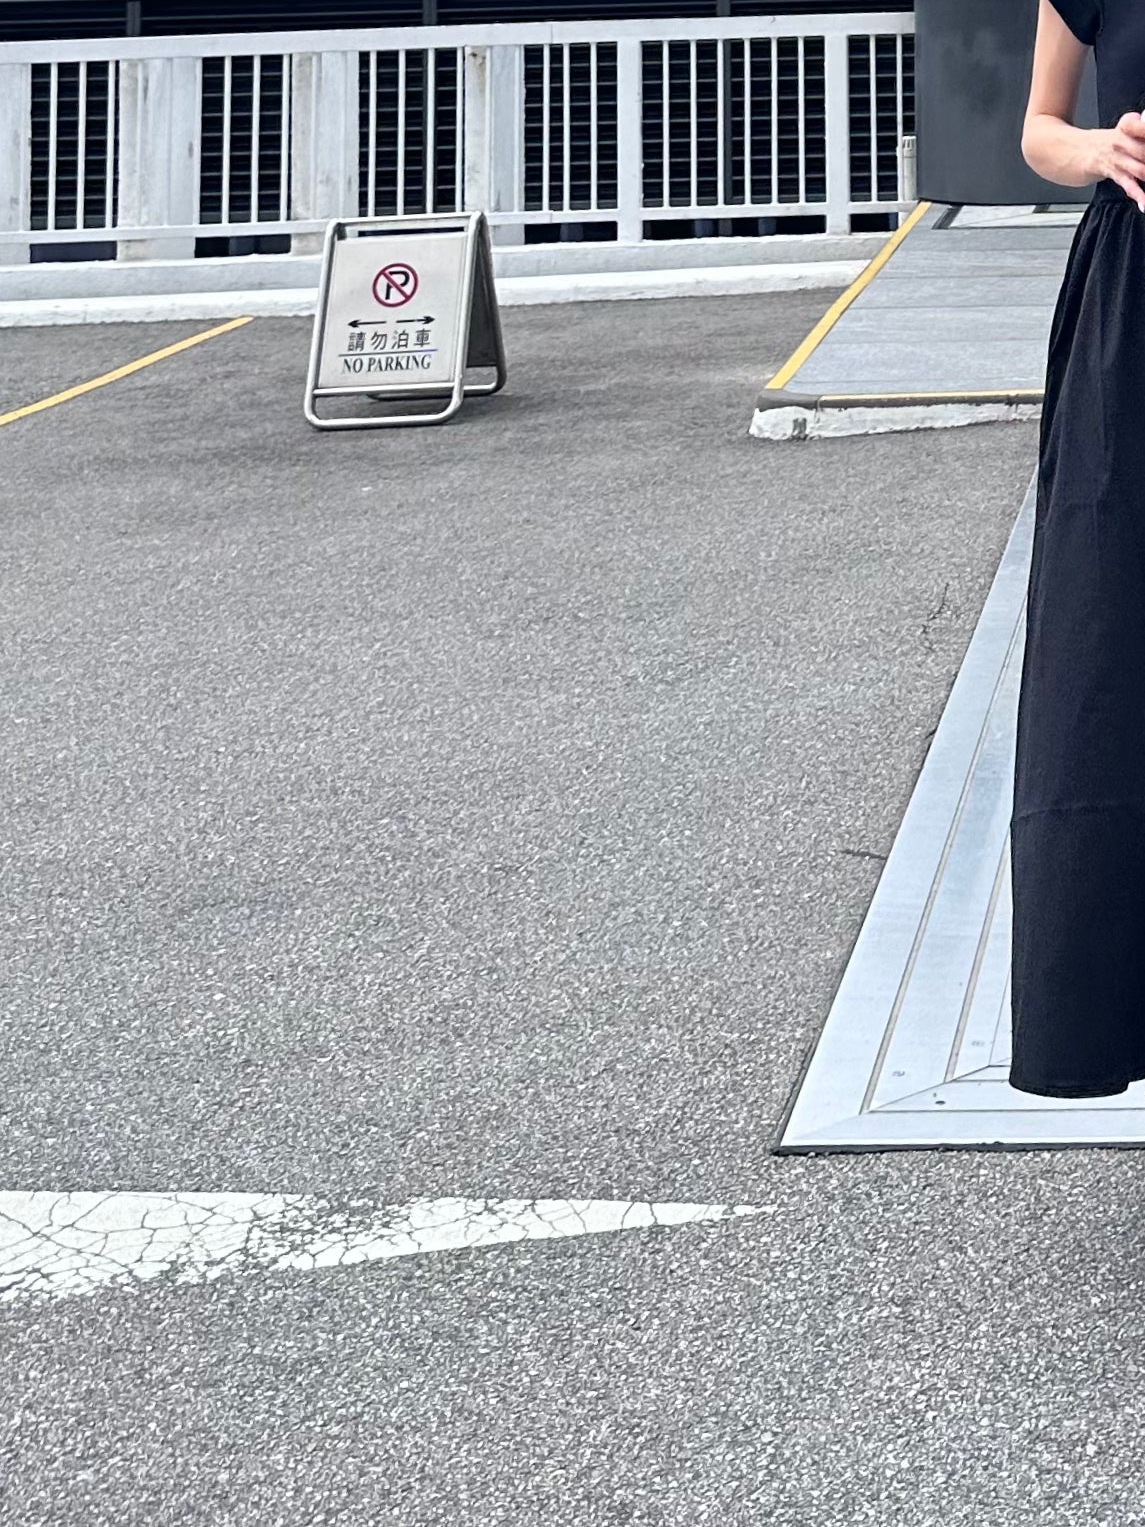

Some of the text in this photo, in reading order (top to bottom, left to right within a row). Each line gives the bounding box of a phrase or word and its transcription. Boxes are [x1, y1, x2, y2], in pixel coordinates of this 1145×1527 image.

[347, 328, 432, 352] 請勿泊車
[341, 354, 432, 374] NO PARKING
